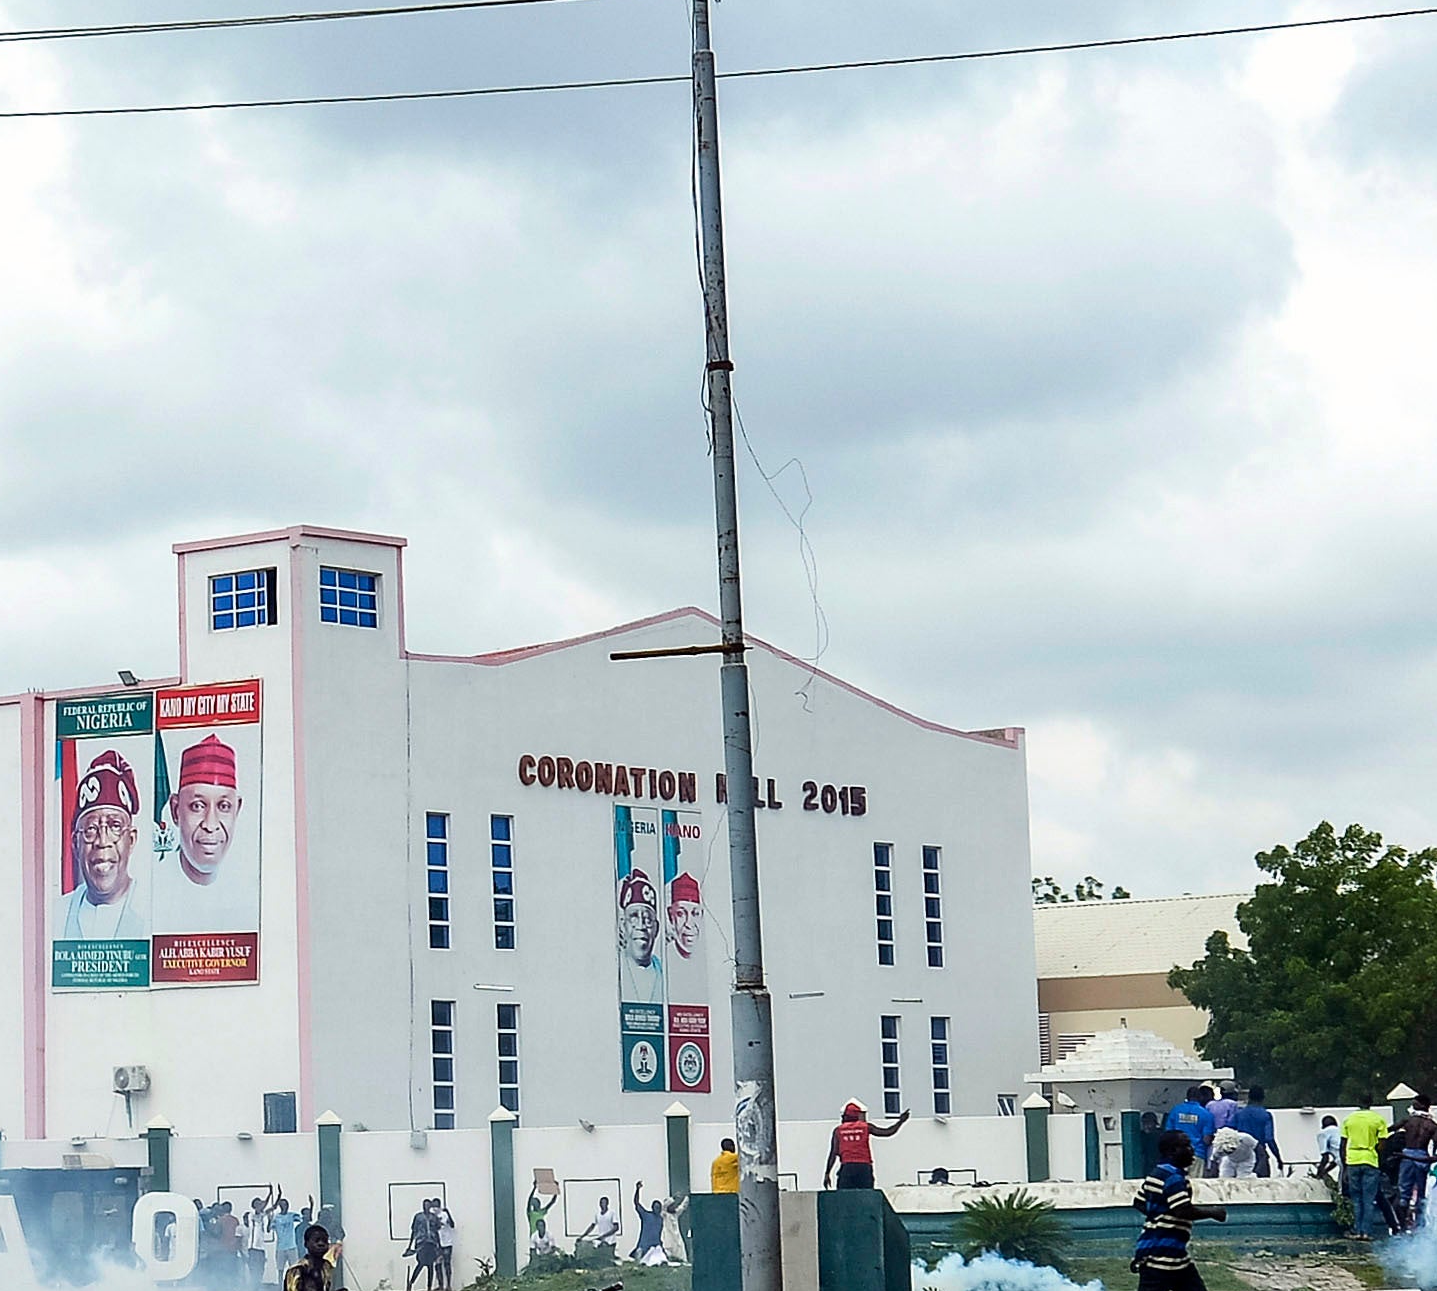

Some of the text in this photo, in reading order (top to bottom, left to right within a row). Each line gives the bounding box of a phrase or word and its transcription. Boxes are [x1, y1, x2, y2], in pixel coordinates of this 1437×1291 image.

[63, 701, 148, 717] FEDERAL REPUBLIC OF
[159, 692, 255, 718] KANO MY CITY MY STATE
[76, 712, 133, 730] NIGERIA
[518, 753, 867, 816] CORONATION HLL 2015
[618, 819, 656, 835] NGERIA
[665, 823, 701, 840] KANO
[54, 950, 76, 961] BOLA
[76, 950, 105, 961] AHMED
[105, 950, 135, 961] TINUBU
[162, 958, 247, 969] EXECUTIVE GOVERNOR
[71, 961, 130, 973] PRESIDENT
